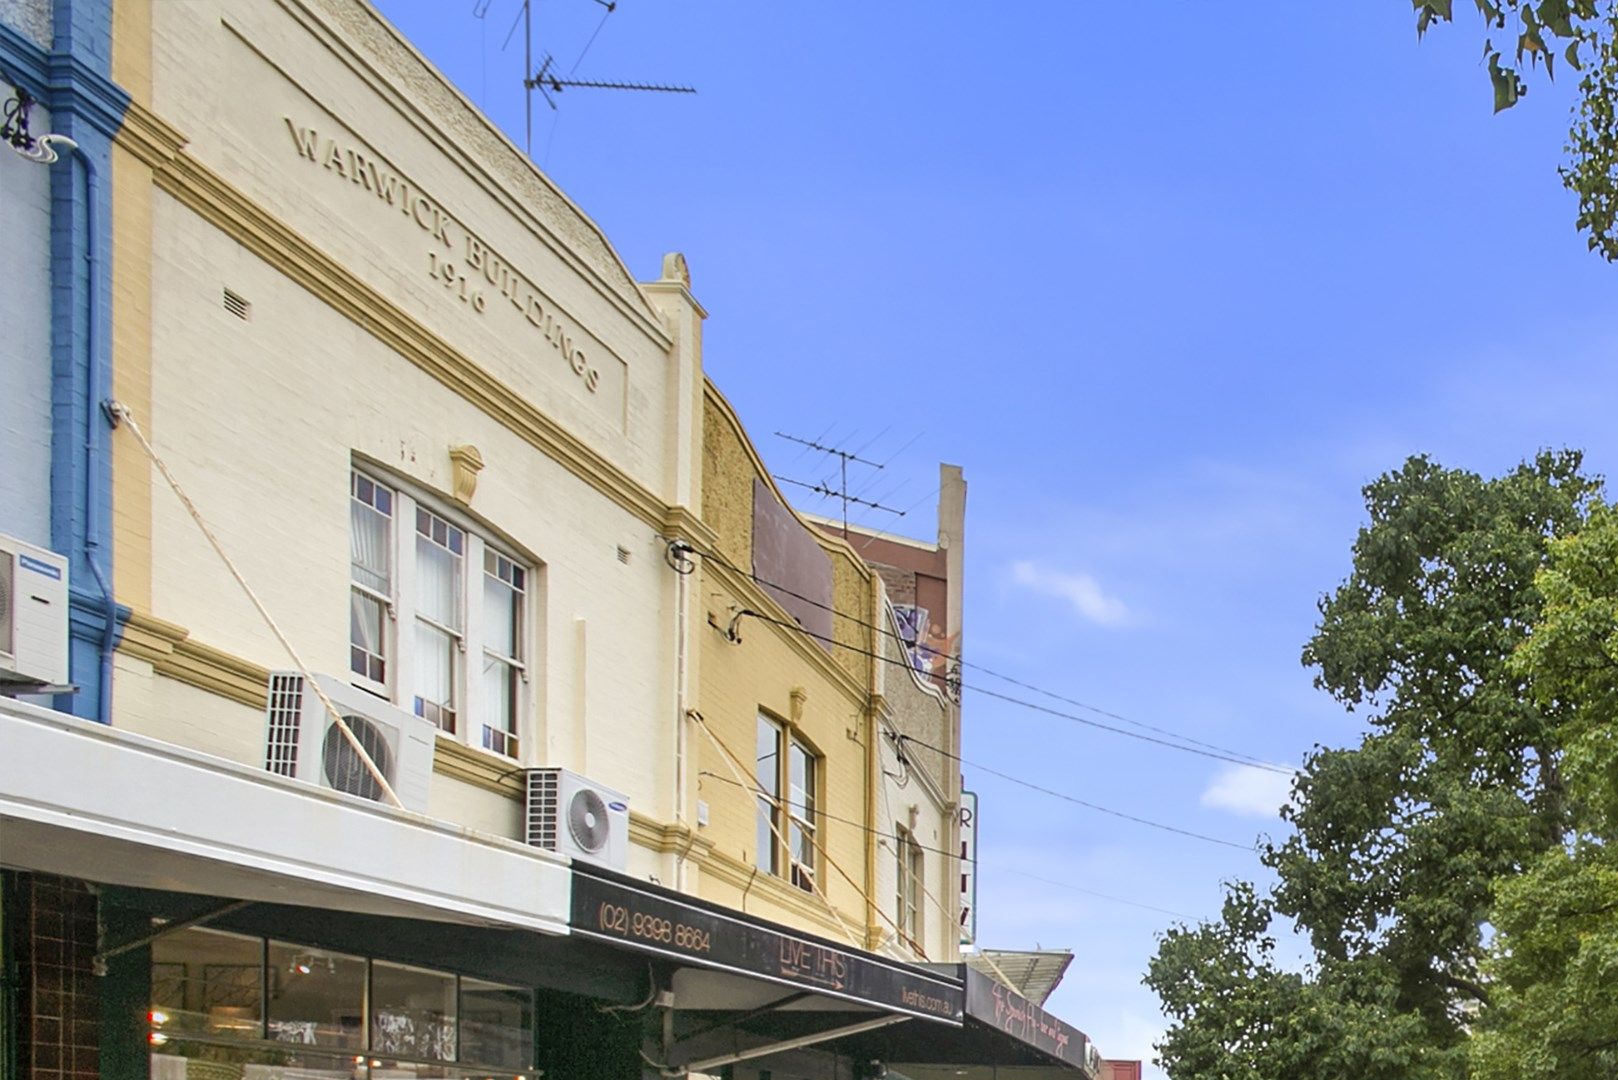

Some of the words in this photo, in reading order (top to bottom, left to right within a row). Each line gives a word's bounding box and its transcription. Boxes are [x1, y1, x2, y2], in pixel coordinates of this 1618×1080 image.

[284, 117, 452, 248] WARWICK
[464, 235, 599, 394] BUILDINGS
[429, 252, 486, 316] 1916
[600, 902, 629, 936] (02)
[633, 912, 671, 943] 9398
[675, 923, 710, 951] 8664
[779, 934, 811, 970] LIVE
[815, 948, 846, 979] THIS
